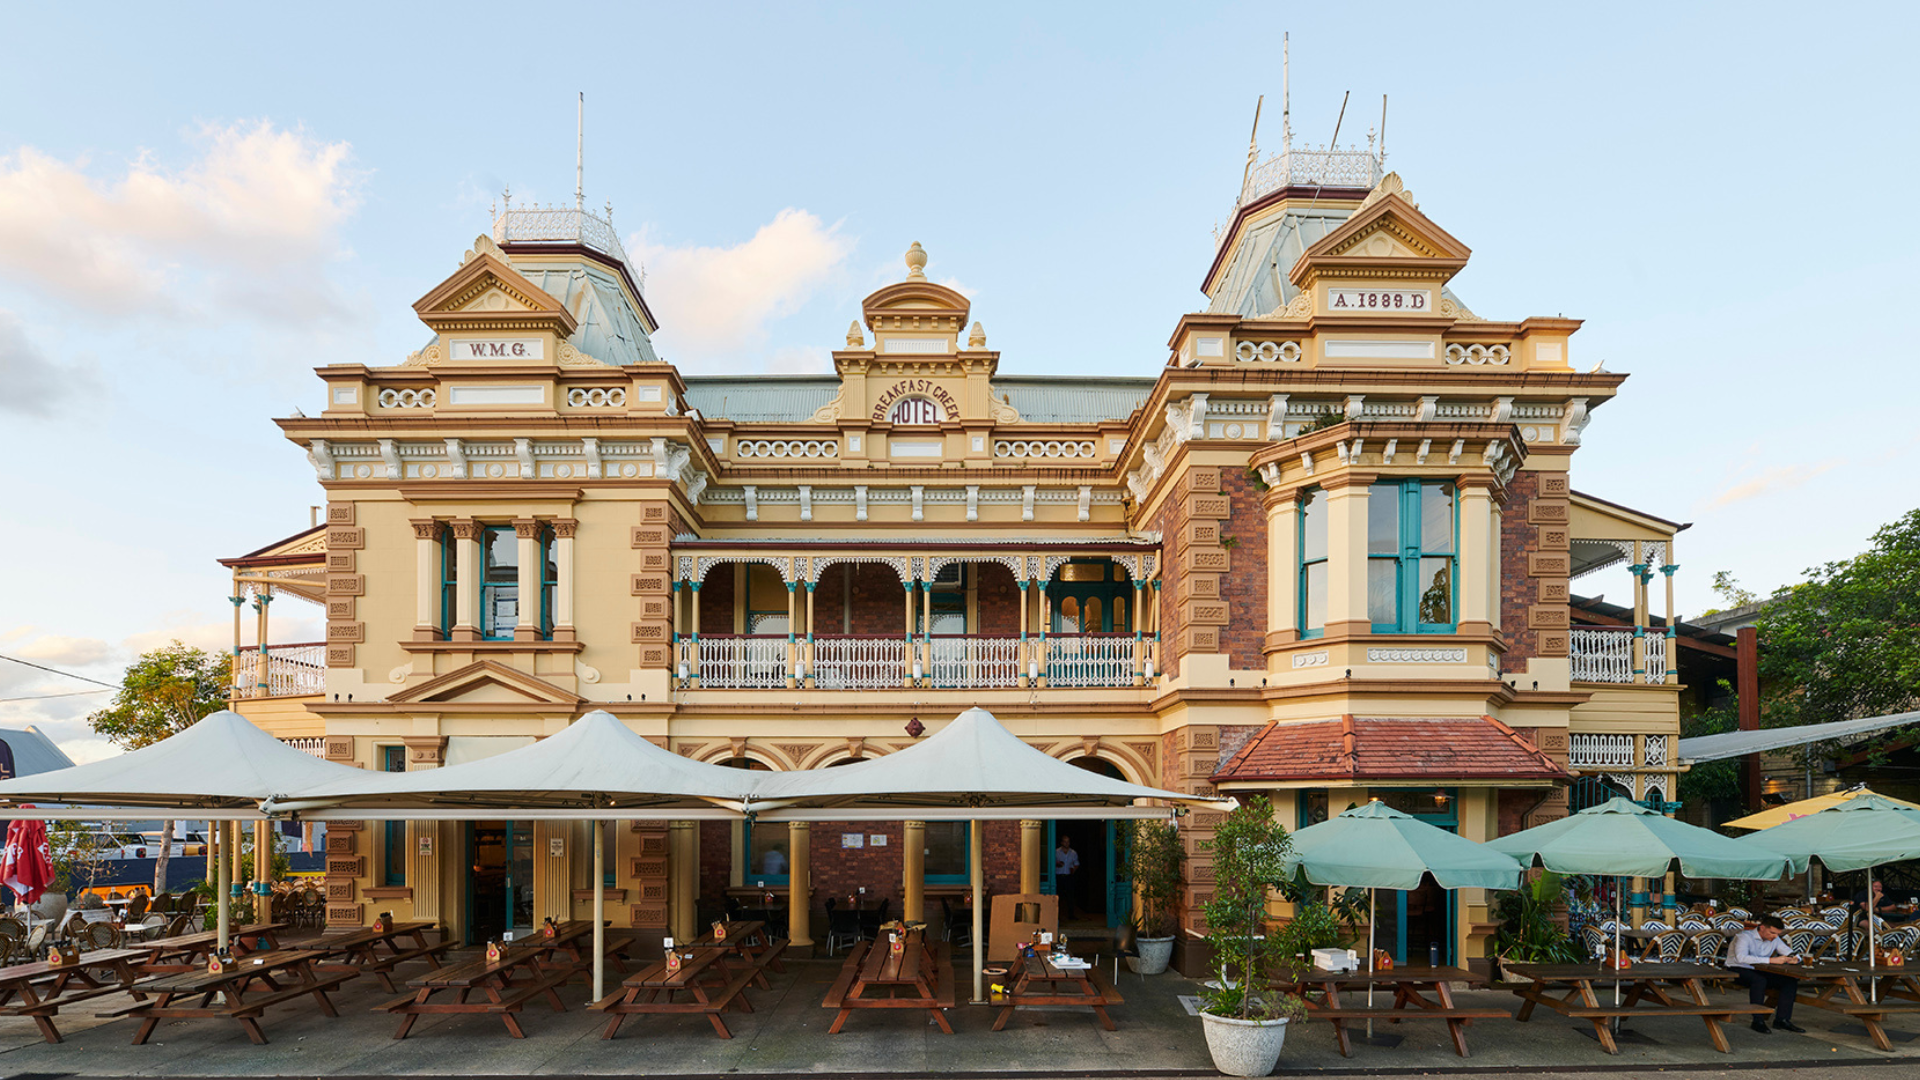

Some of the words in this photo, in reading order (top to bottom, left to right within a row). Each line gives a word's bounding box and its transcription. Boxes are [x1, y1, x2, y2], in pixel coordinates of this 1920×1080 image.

[1334, 293, 1425, 309] A.1889.D
[470, 342, 531, 357] W.M.G.
[872, 379, 933, 421] BREAKFAST
[932, 386, 961, 420] CREEK
[891, 398, 941, 424] HOTEL
